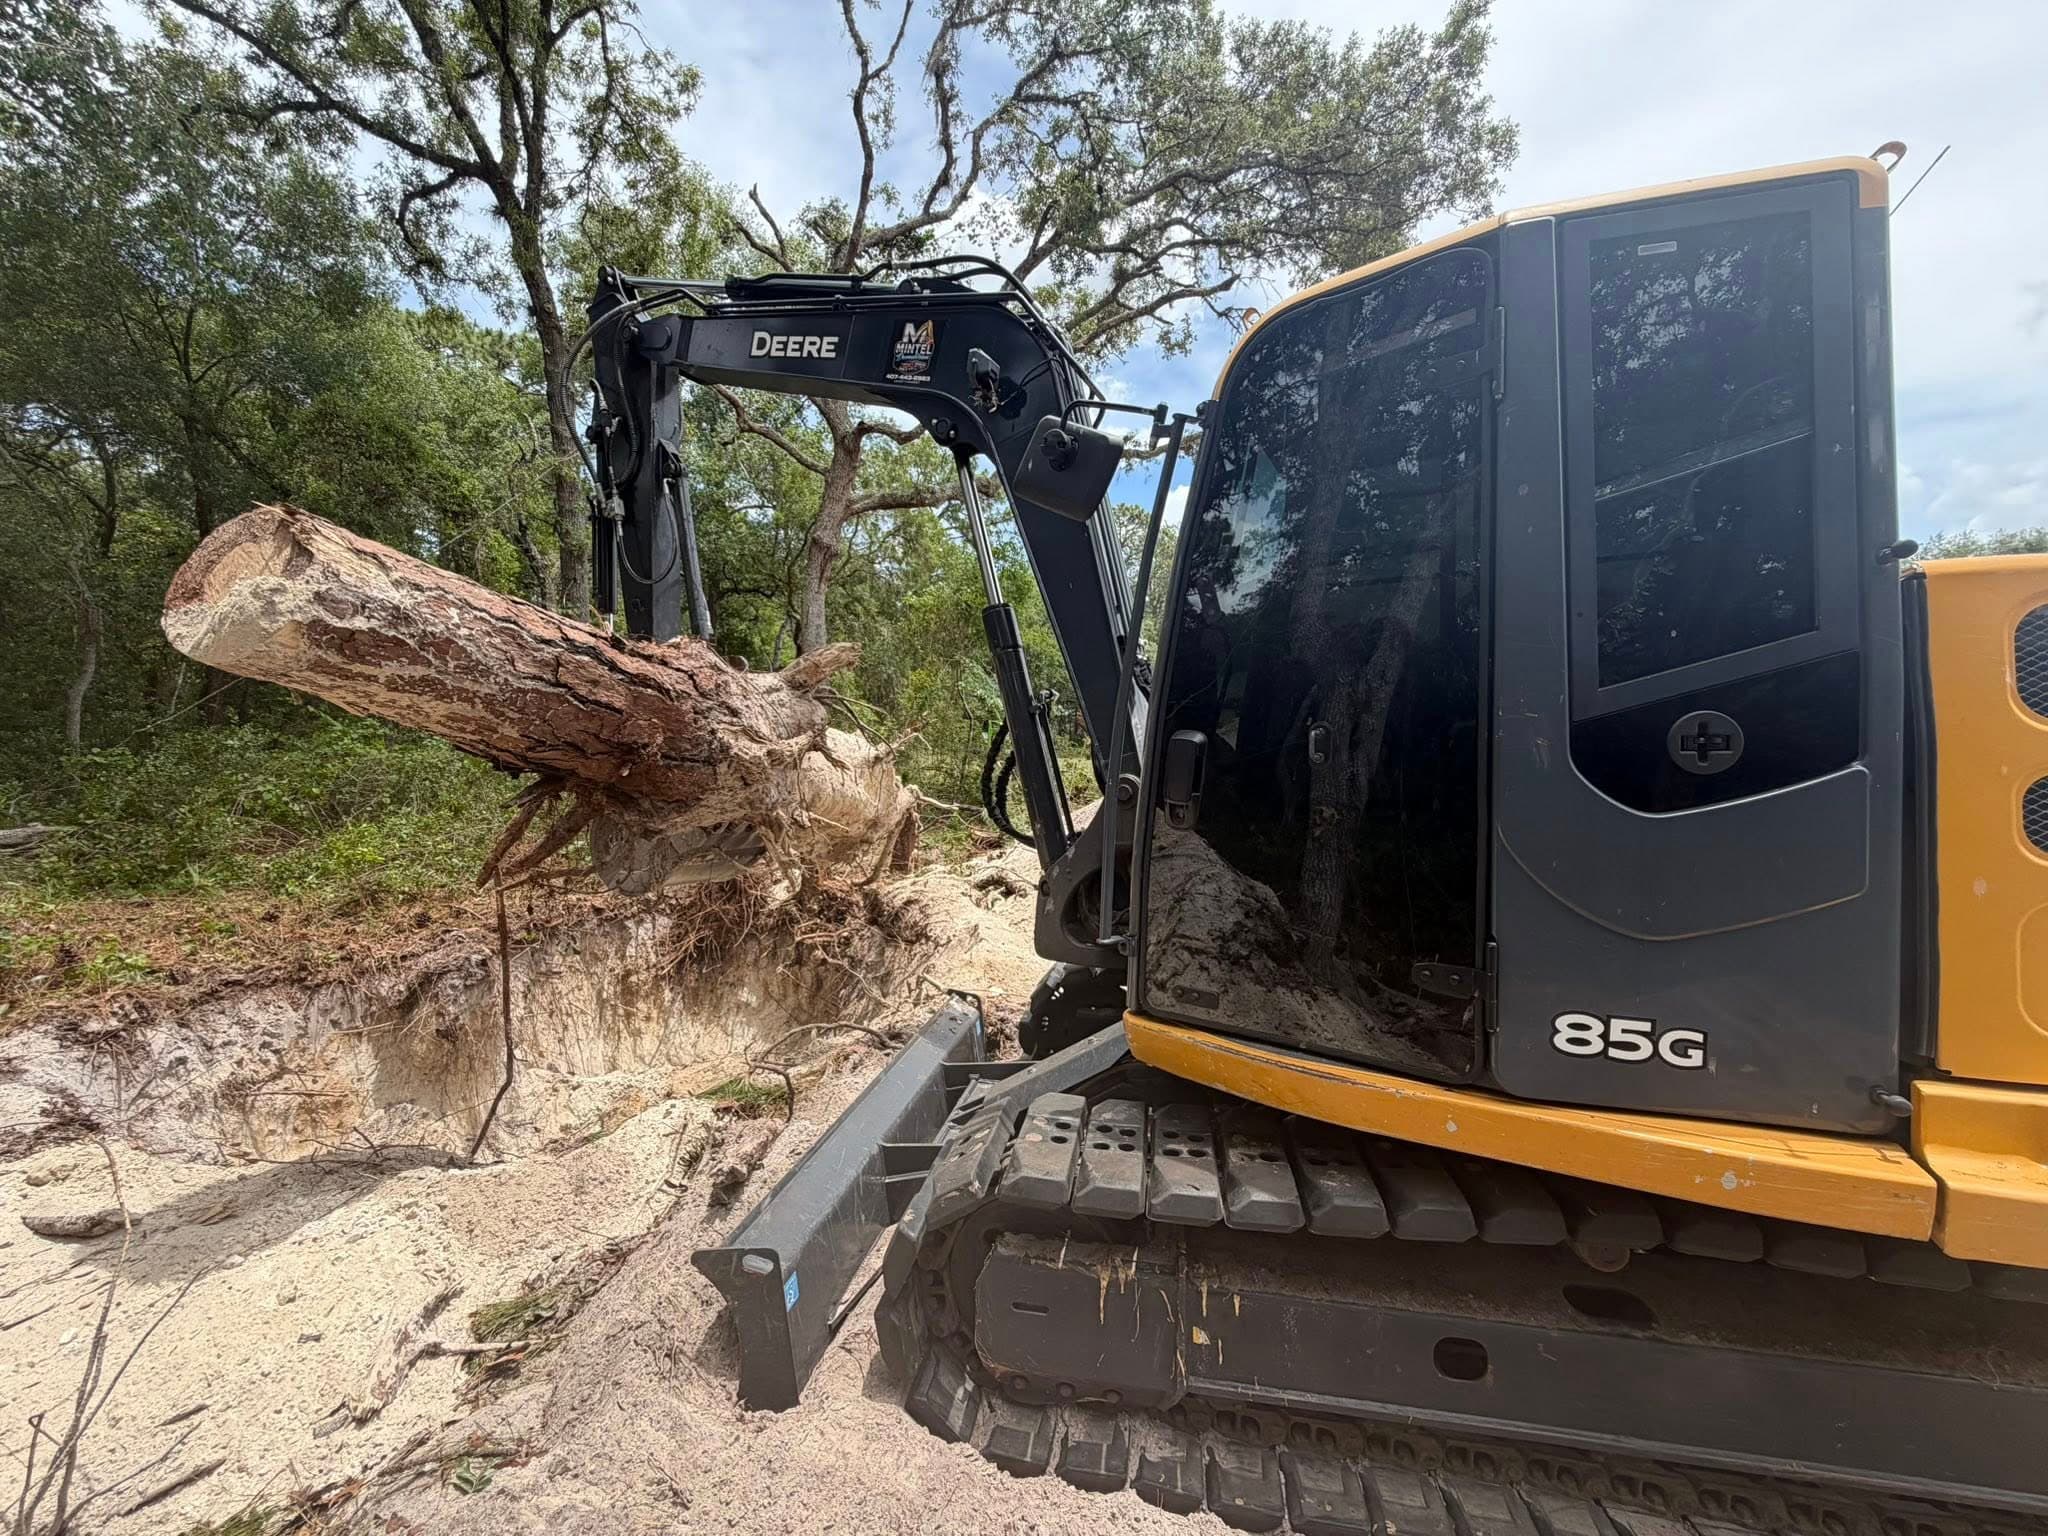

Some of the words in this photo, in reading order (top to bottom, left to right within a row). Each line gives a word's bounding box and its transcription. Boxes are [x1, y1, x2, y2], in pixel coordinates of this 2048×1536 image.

[750, 331, 839, 358] DEERE
[895, 343, 933, 355] MINTEL
[1552, 1013, 1705, 1067] 85G
